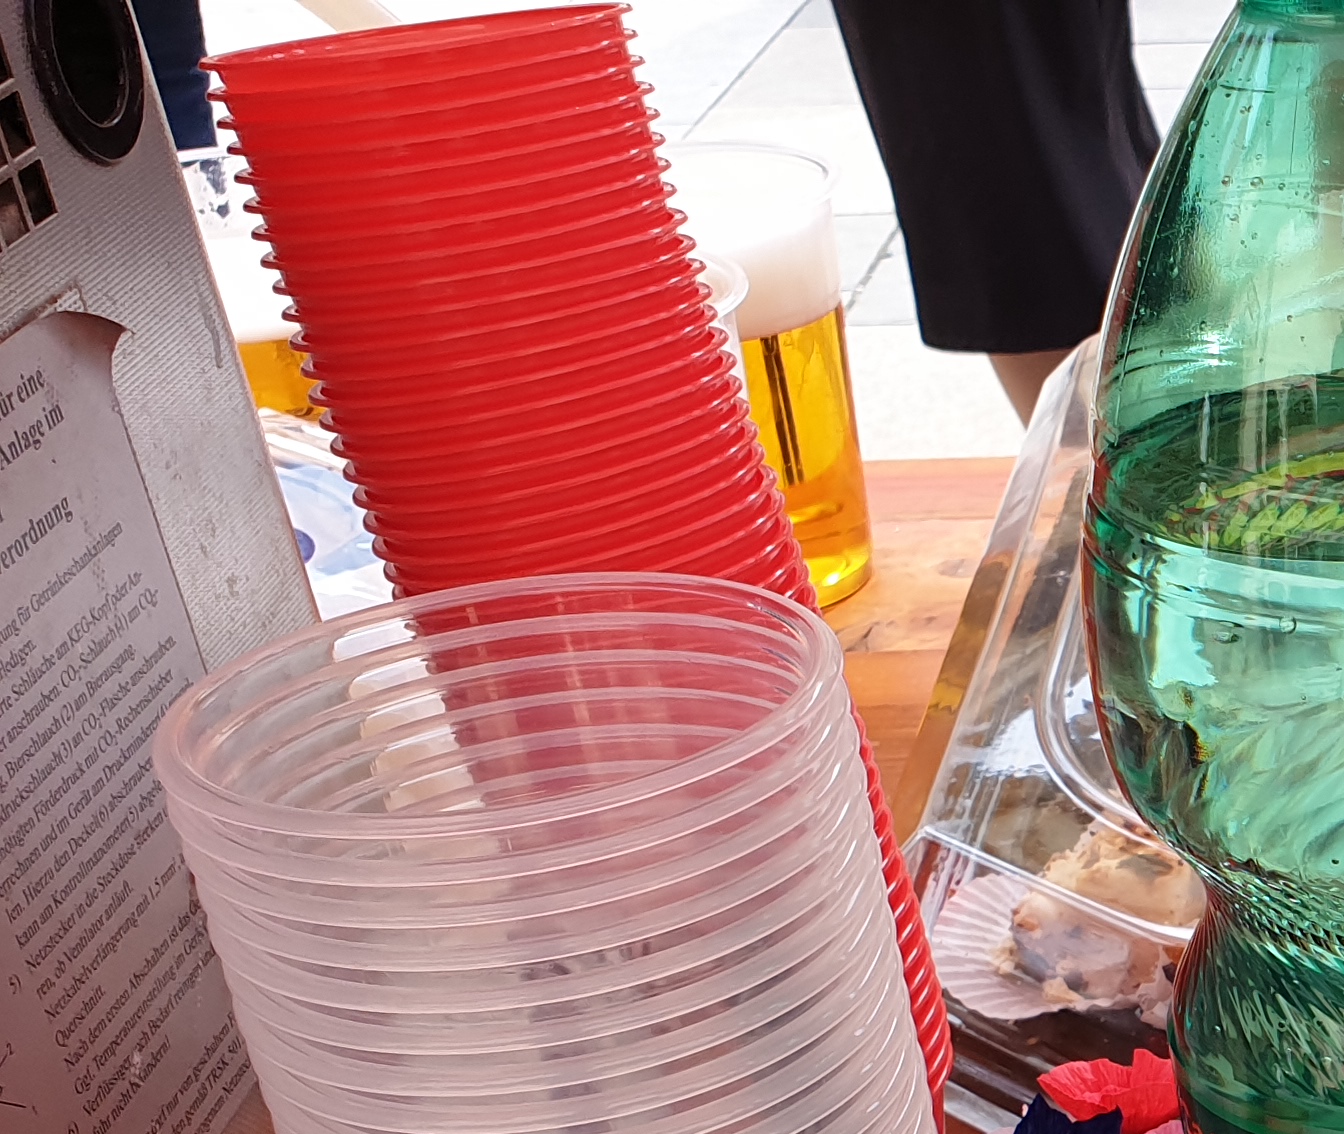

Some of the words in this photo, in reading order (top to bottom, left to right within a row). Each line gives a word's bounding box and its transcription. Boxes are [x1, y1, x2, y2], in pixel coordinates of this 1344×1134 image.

[16, 366, 45, 403] eine
[43, 402, 64, 438] im
[0, 495, 74, 573] erordnung
